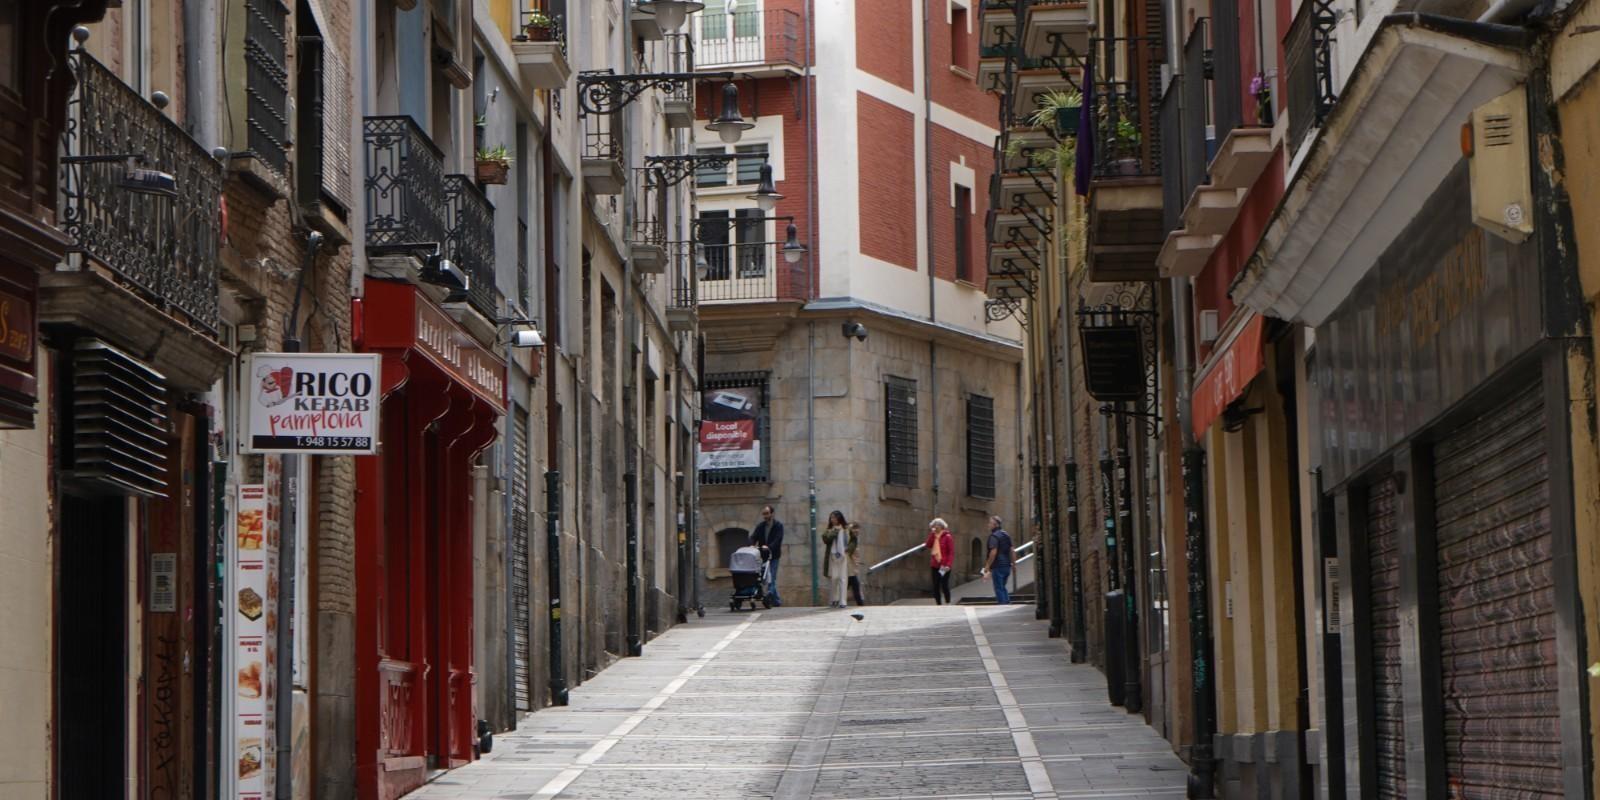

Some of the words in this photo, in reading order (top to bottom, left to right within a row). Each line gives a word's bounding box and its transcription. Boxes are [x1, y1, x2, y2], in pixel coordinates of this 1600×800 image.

[296, 372, 372, 397] RICO
[294, 398, 369, 411] KEBAB
[270, 406, 363, 439] pamplona
[715, 422, 738, 431] Local
[706, 430, 748, 440] disponible
[296, 436, 304, 446] T.
[306, 436, 325, 447] 948
[327, 437, 339, 447] 15
[341, 437, 354, 447] 57
[355, 437, 369, 447] 88
